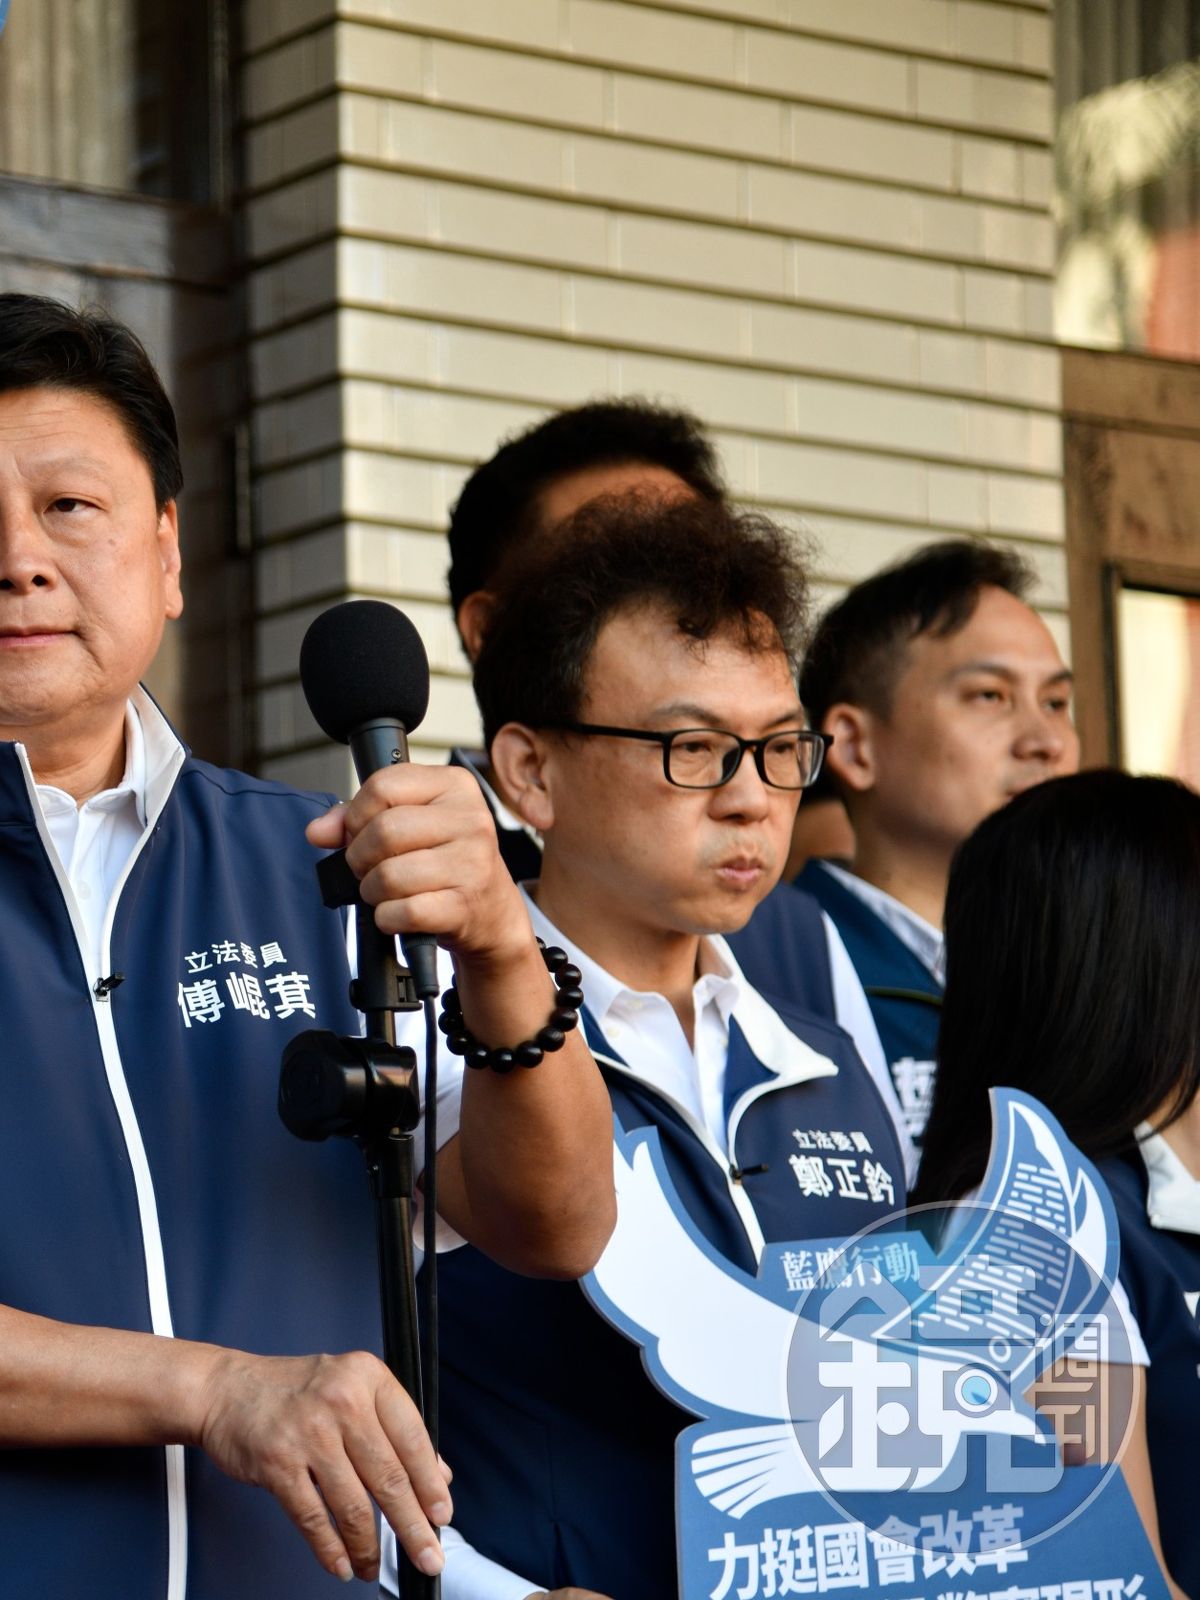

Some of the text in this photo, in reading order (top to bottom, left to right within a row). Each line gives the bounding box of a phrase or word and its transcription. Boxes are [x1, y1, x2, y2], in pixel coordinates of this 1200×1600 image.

[184, 939, 288, 974] 立法委員
[177, 971, 317, 1028] 傅崐萁
[791, 1128, 874, 1155] 立法委員
[788, 1153, 896, 1206] 鄭正鈐
[779, 1242, 920, 1292] 藍鷹行動
[707, 1503, 1030, 1600] 力挺國會改革
